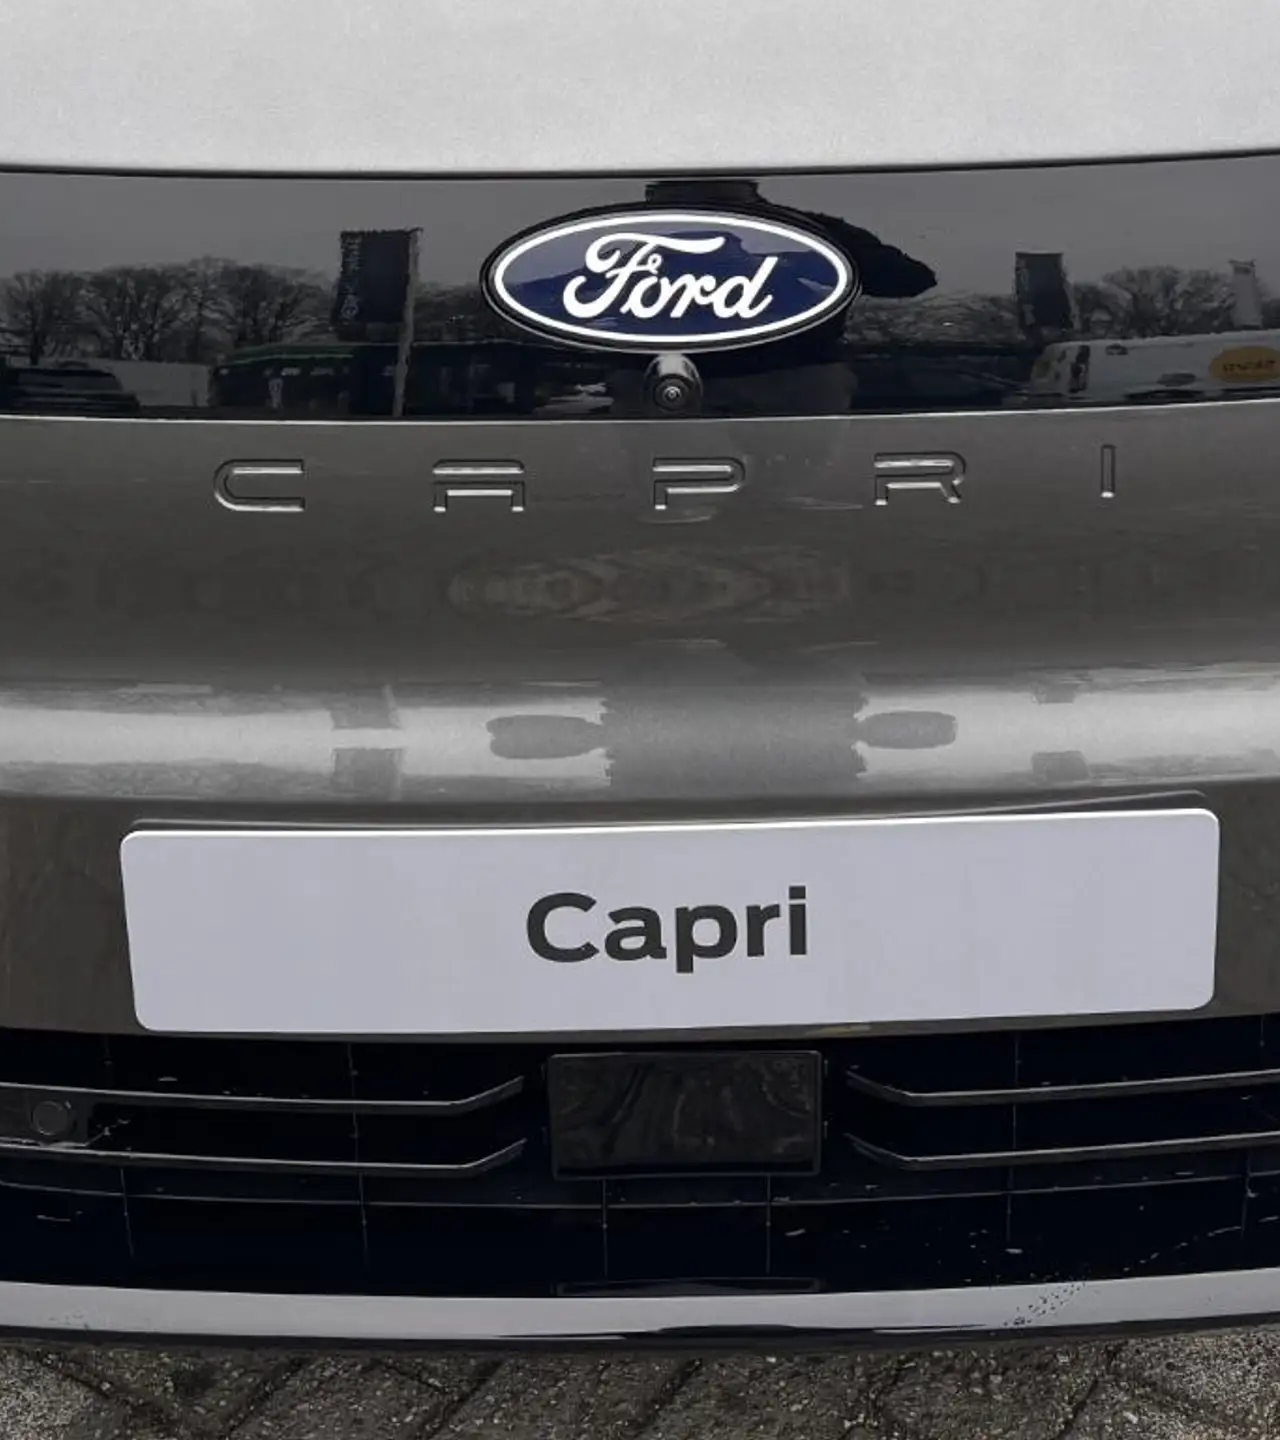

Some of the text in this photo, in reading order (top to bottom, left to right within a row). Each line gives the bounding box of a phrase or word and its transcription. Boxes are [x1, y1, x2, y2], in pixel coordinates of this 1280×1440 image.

[562, 232, 778, 320] Ford
[212, 443, 1115, 513] CAPRI
[526, 885, 807, 974] Capri
